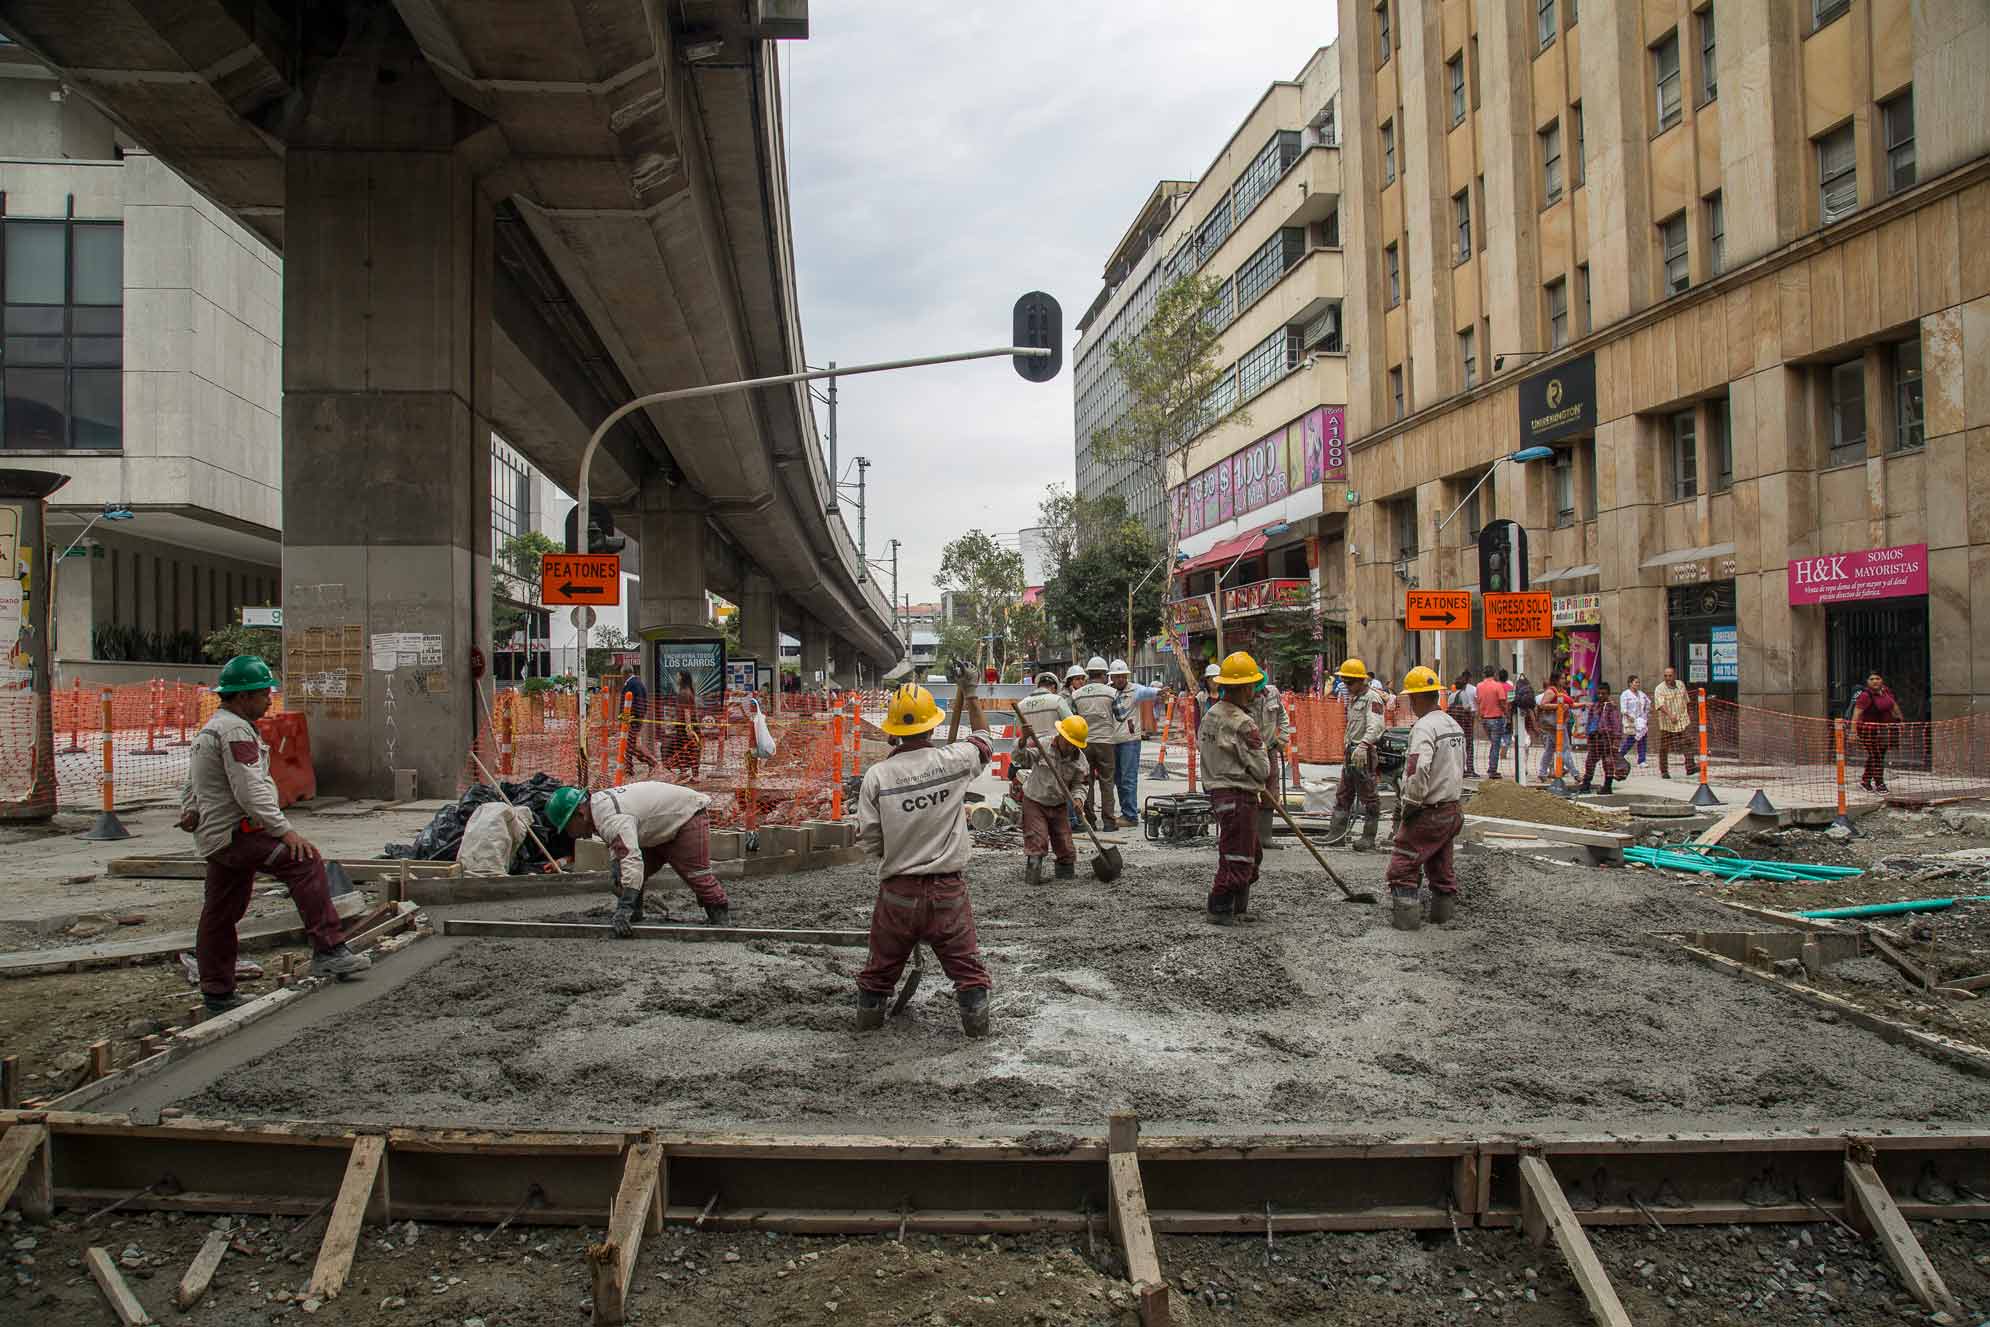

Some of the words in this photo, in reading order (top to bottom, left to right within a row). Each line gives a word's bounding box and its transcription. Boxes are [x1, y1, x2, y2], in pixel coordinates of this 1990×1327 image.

[1867, 548, 1904, 562] SOMOS
[545, 562, 617, 578] PEATONES
[1795, 556, 1849, 585] H&K
[1854, 561, 1919, 578] MAYORISTAS
[1410, 597, 1467, 609] PEATONES
[1488, 599, 1525, 615] INGRESO
[1527, 598, 1549, 614] SOLO
[1496, 617, 1542, 633] RESIDENTE
[664, 658, 681, 668] LOS
[682, 657, 716, 668] CARROS
[901, 788, 951, 813] CCYP
